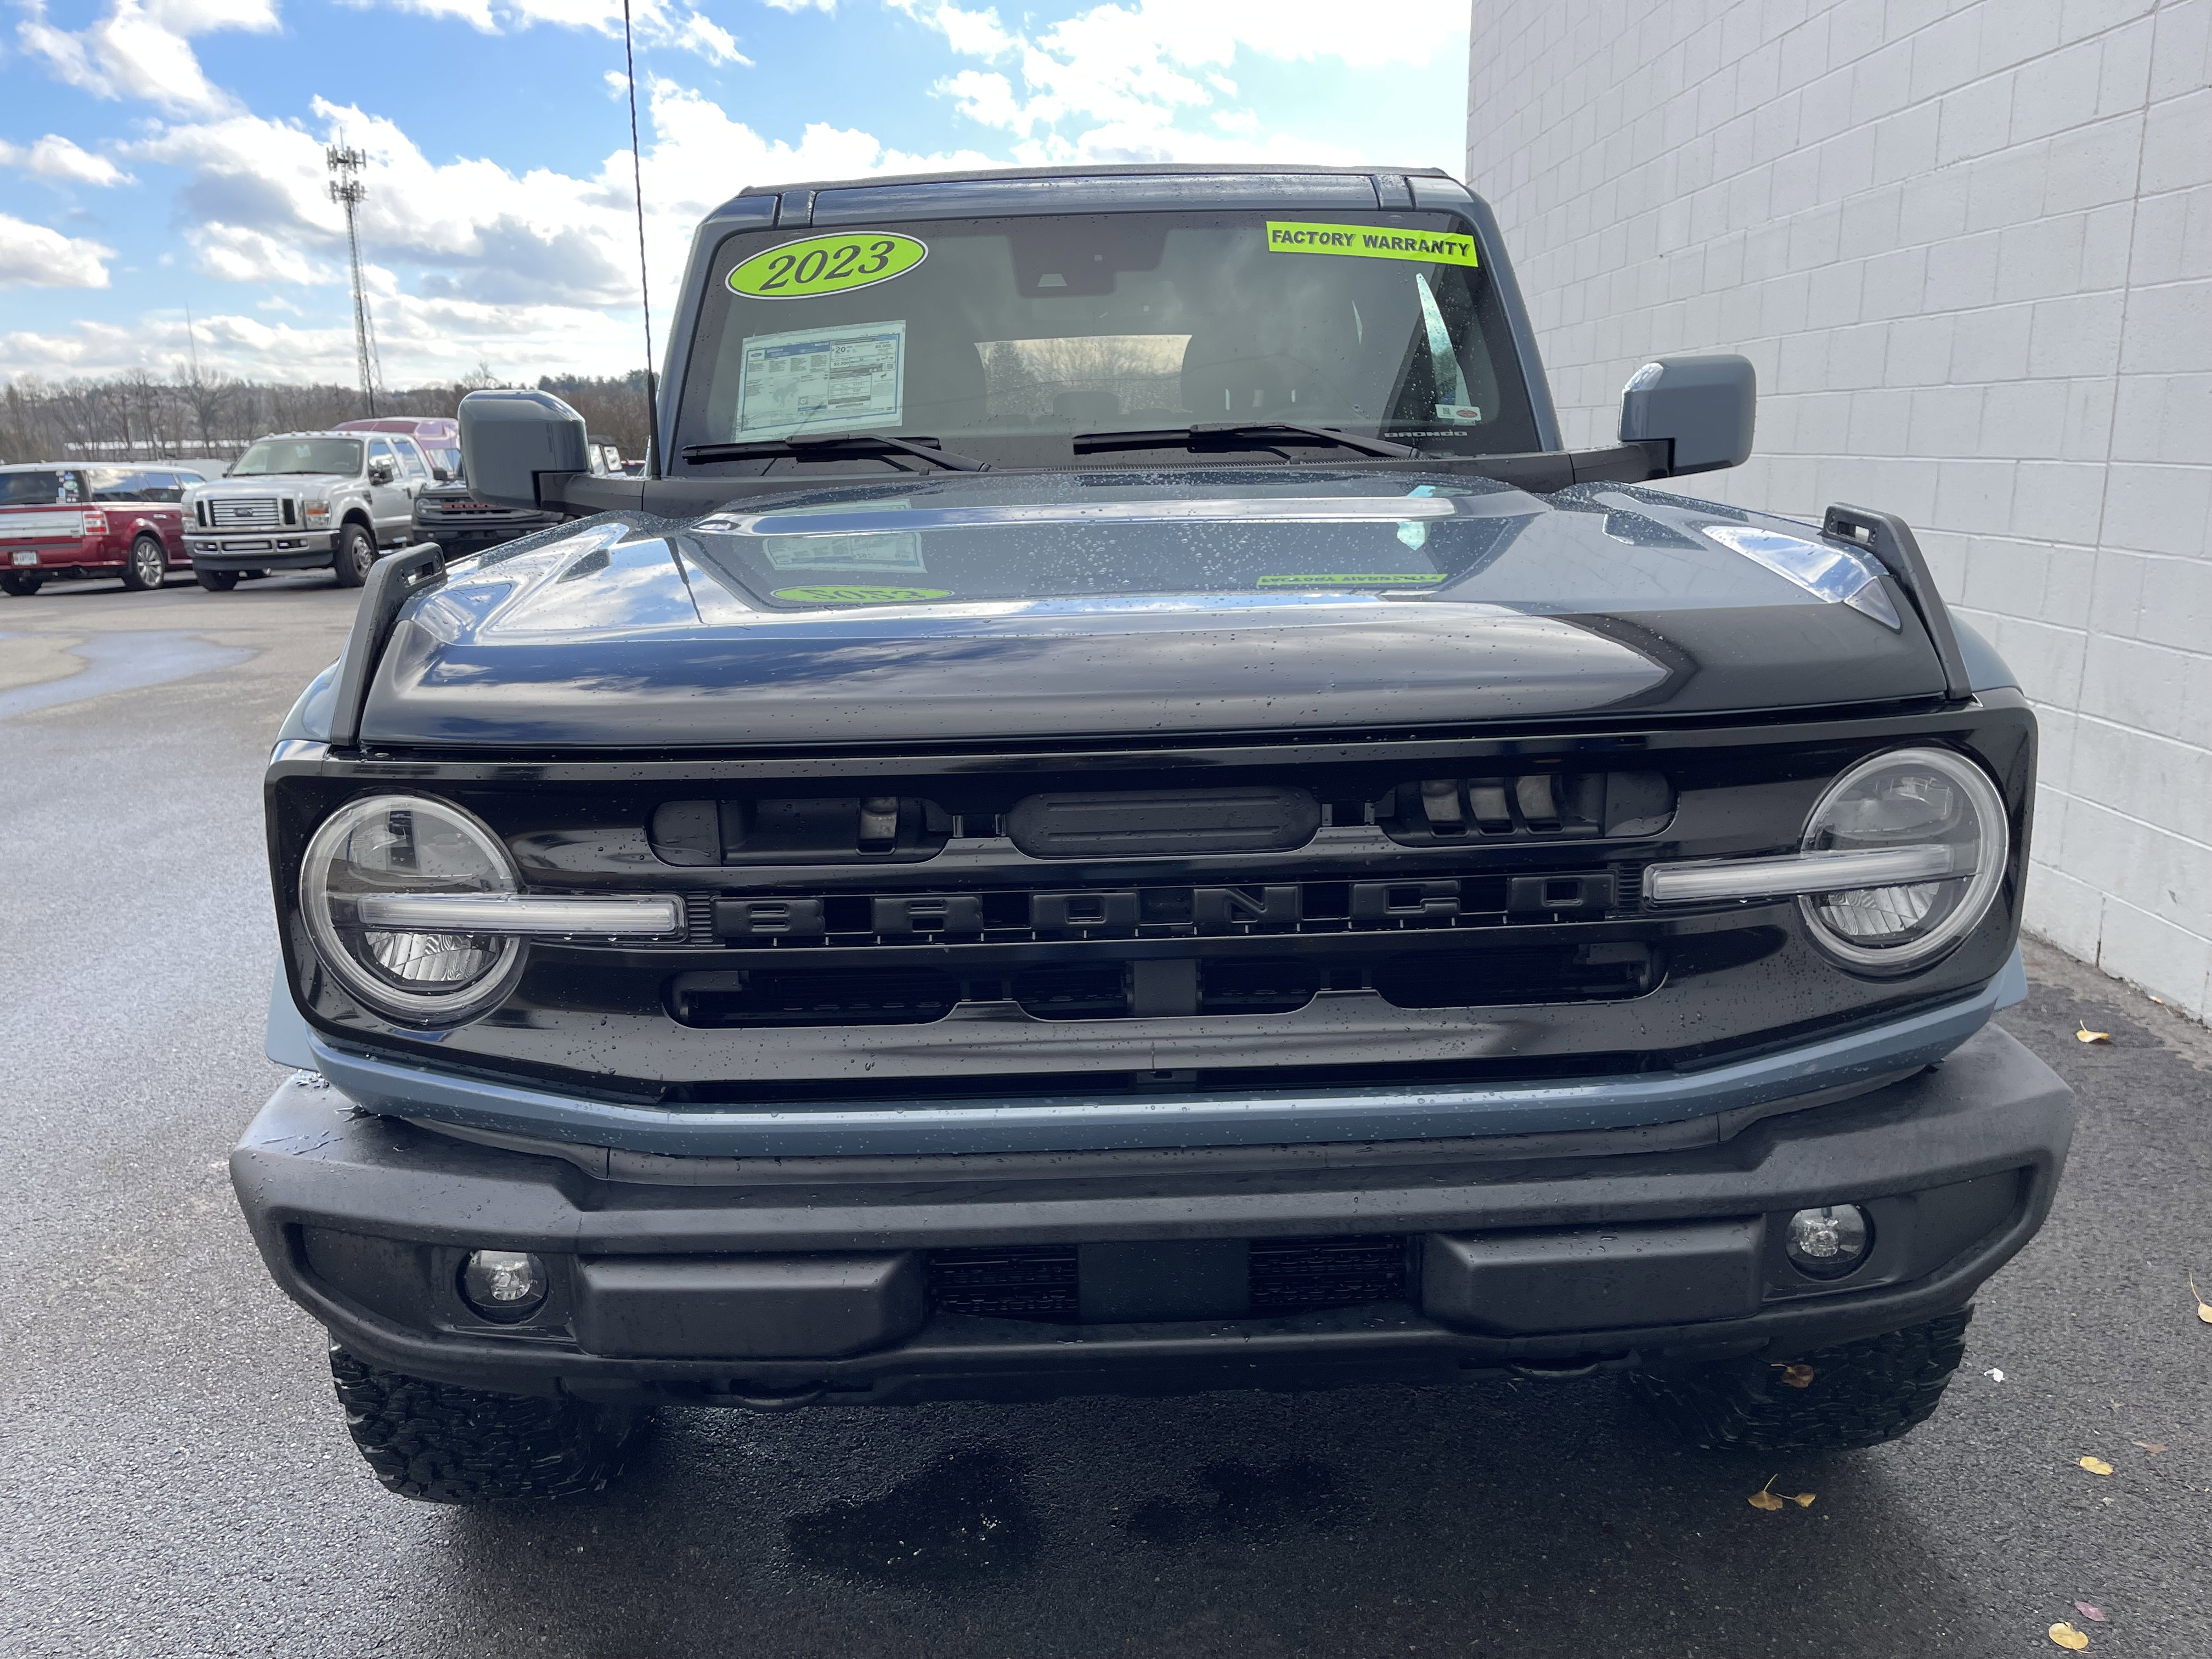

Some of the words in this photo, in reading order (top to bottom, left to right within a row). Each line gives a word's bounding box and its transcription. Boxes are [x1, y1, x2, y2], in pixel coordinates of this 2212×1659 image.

[758, 240, 895, 291] 2023
[1272, 229, 1357, 247] FACTORY
[1362, 234, 1471, 257] WARRANTY
[714, 873, 1617, 937] BRONCO
